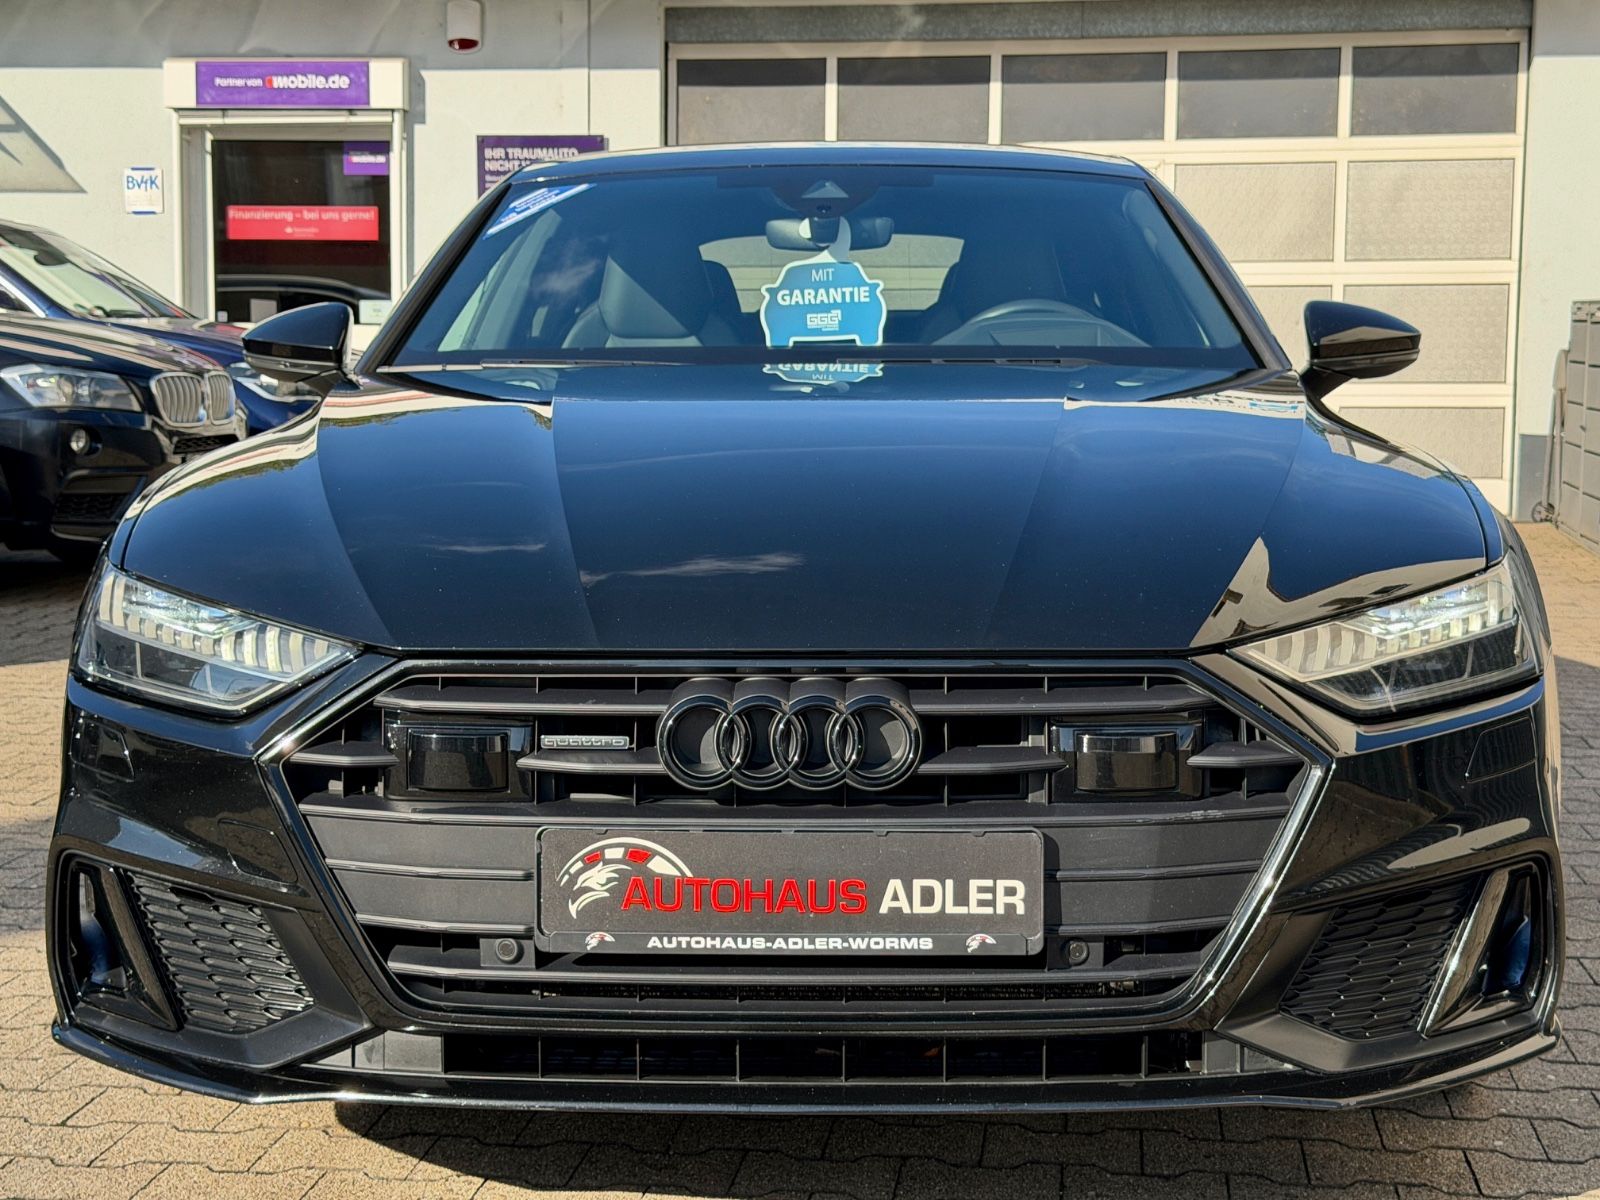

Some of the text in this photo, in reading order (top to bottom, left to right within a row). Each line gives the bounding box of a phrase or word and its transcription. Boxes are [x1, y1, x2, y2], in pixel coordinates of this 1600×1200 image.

[271, 74, 350, 89] mobile.de
[484, 147, 505, 159] IHR
[228, 209, 294, 222] Finanzierung
[302, 209, 319, 220] bei
[321, 211, 340, 220] uns
[341, 210, 375, 222] gerne!
[811, 268, 834, 282] MIT
[776, 286, 870, 306] GARANTIE
[545, 737, 625, 747] quattro
[620, 876, 1026, 915] AUTOHAUS ADLER
[647, 936, 933, 950] AUTOHAUS-ADLER-WORMS
